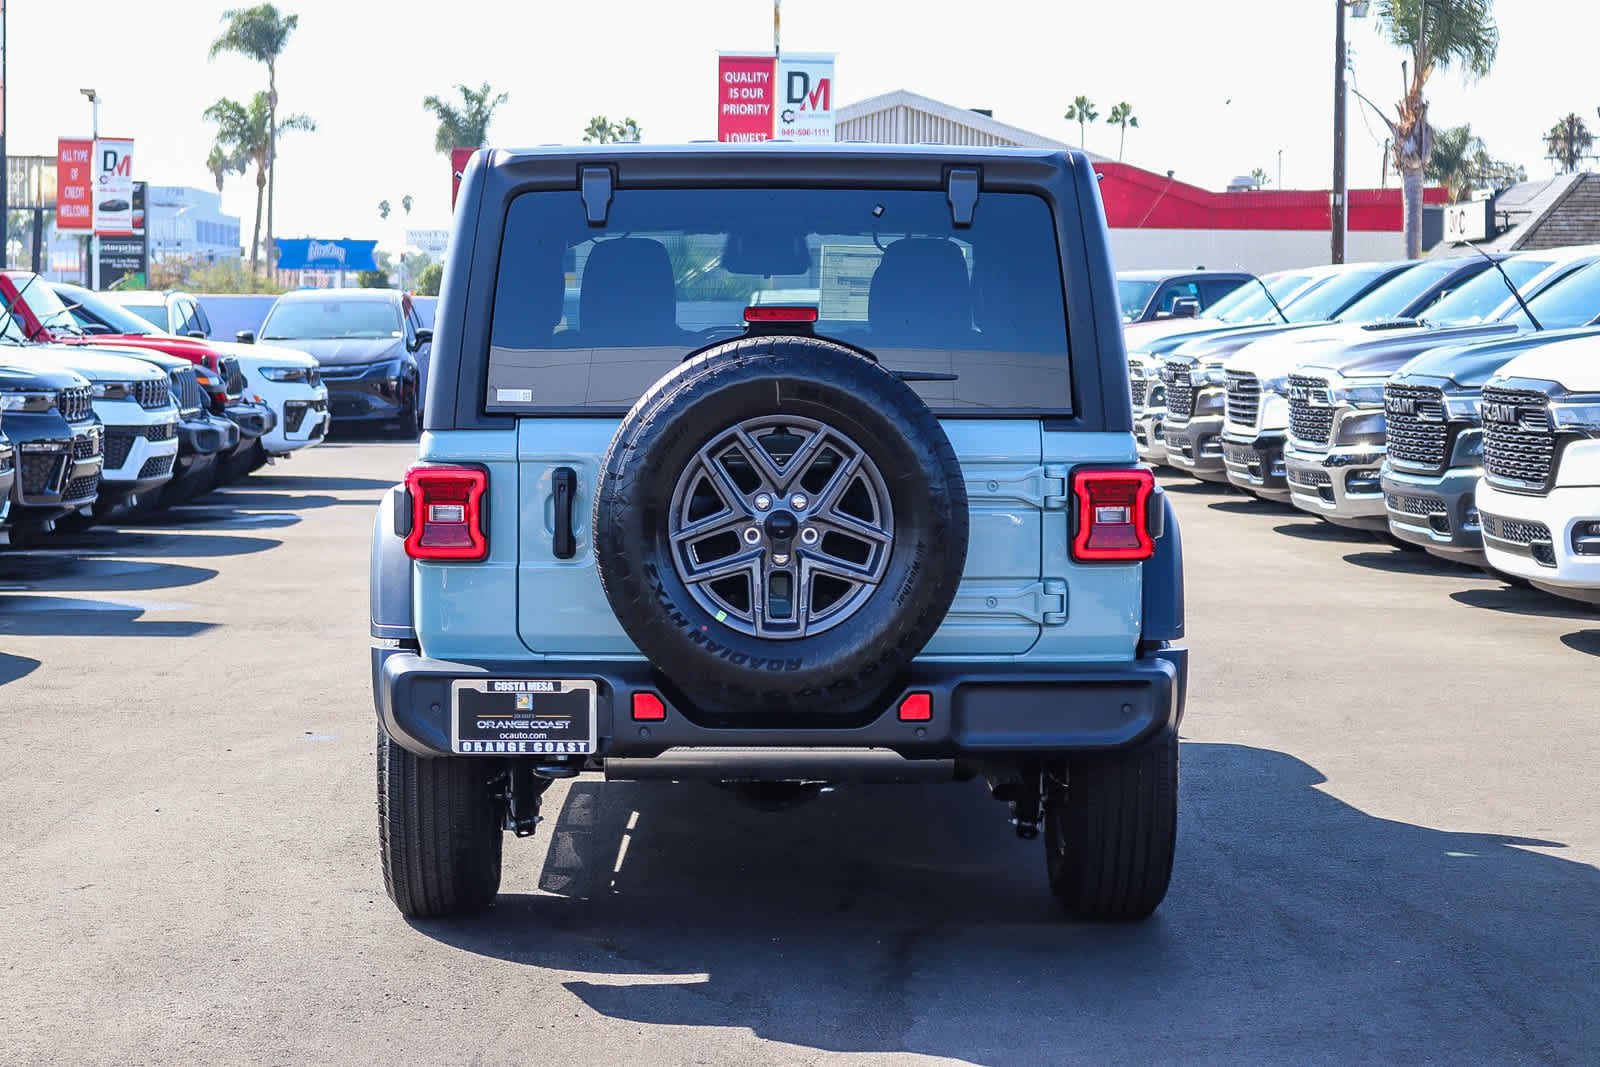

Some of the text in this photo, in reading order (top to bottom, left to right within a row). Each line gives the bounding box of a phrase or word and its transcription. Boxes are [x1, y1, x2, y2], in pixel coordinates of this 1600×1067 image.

[724, 72, 769, 83] QUALITY
[730, 88, 764, 98] IS OUR
[723, 104, 770, 115] PRIORITY
[62, 149, 88, 162] ALL TYPE
[70, 168, 79, 180] OF
[64, 186, 85, 199] CREDIT
[61, 205, 89, 217] WELCOME
[1482, 403, 1516, 422] RAM
[494, 682, 554, 691] COSTA MESA
[477, 720, 571, 729] ORANGE COAST
[499, 732, 547, 740] ocauto.com
[462, 742, 587, 752] ORANGE COAST
